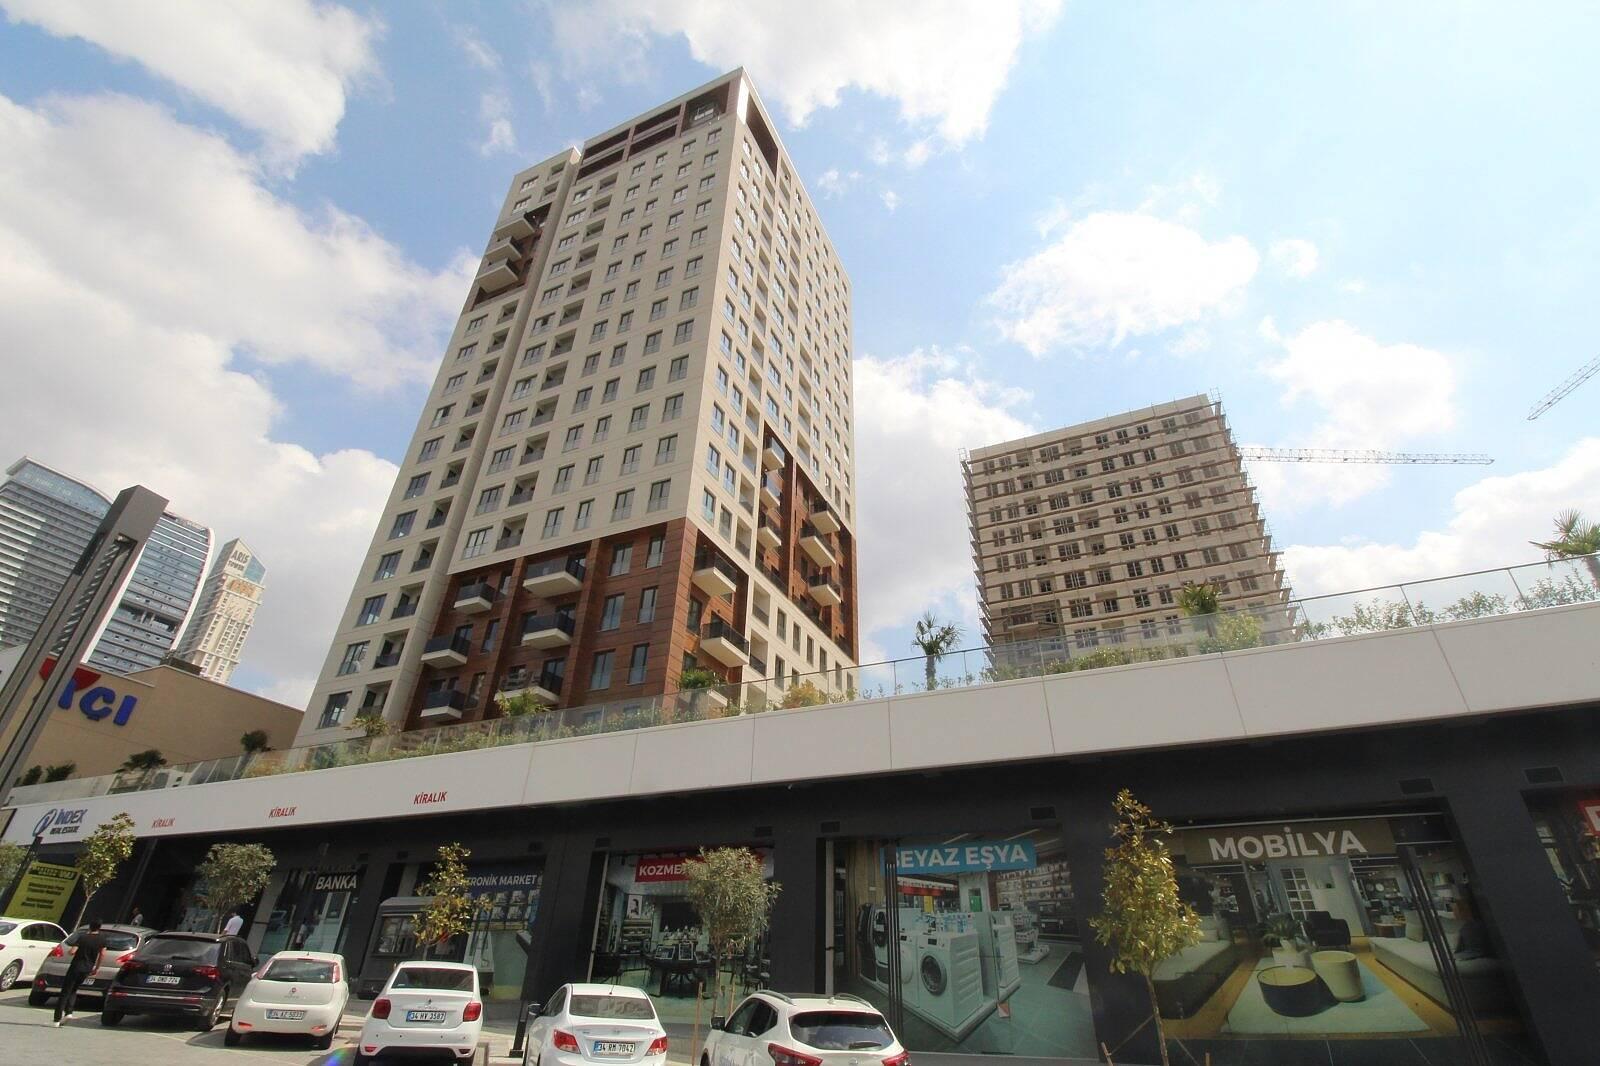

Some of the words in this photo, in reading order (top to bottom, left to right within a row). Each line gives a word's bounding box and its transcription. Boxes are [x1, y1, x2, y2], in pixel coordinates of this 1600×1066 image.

[230, 549, 249, 564] ARIS
[413, 791, 448, 805] KİRALIK
[269, 806, 297, 819] KİRALIK
[1208, 826, 1368, 861] MOBİLYA
[965, 844, 1028, 871] EŞYA
[315, 874, 357, 890] BANKA
[499, 874, 538, 886] MARKET
[598, 1043, 606, 1052] 34
[608, 1043, 616, 1052] RM
